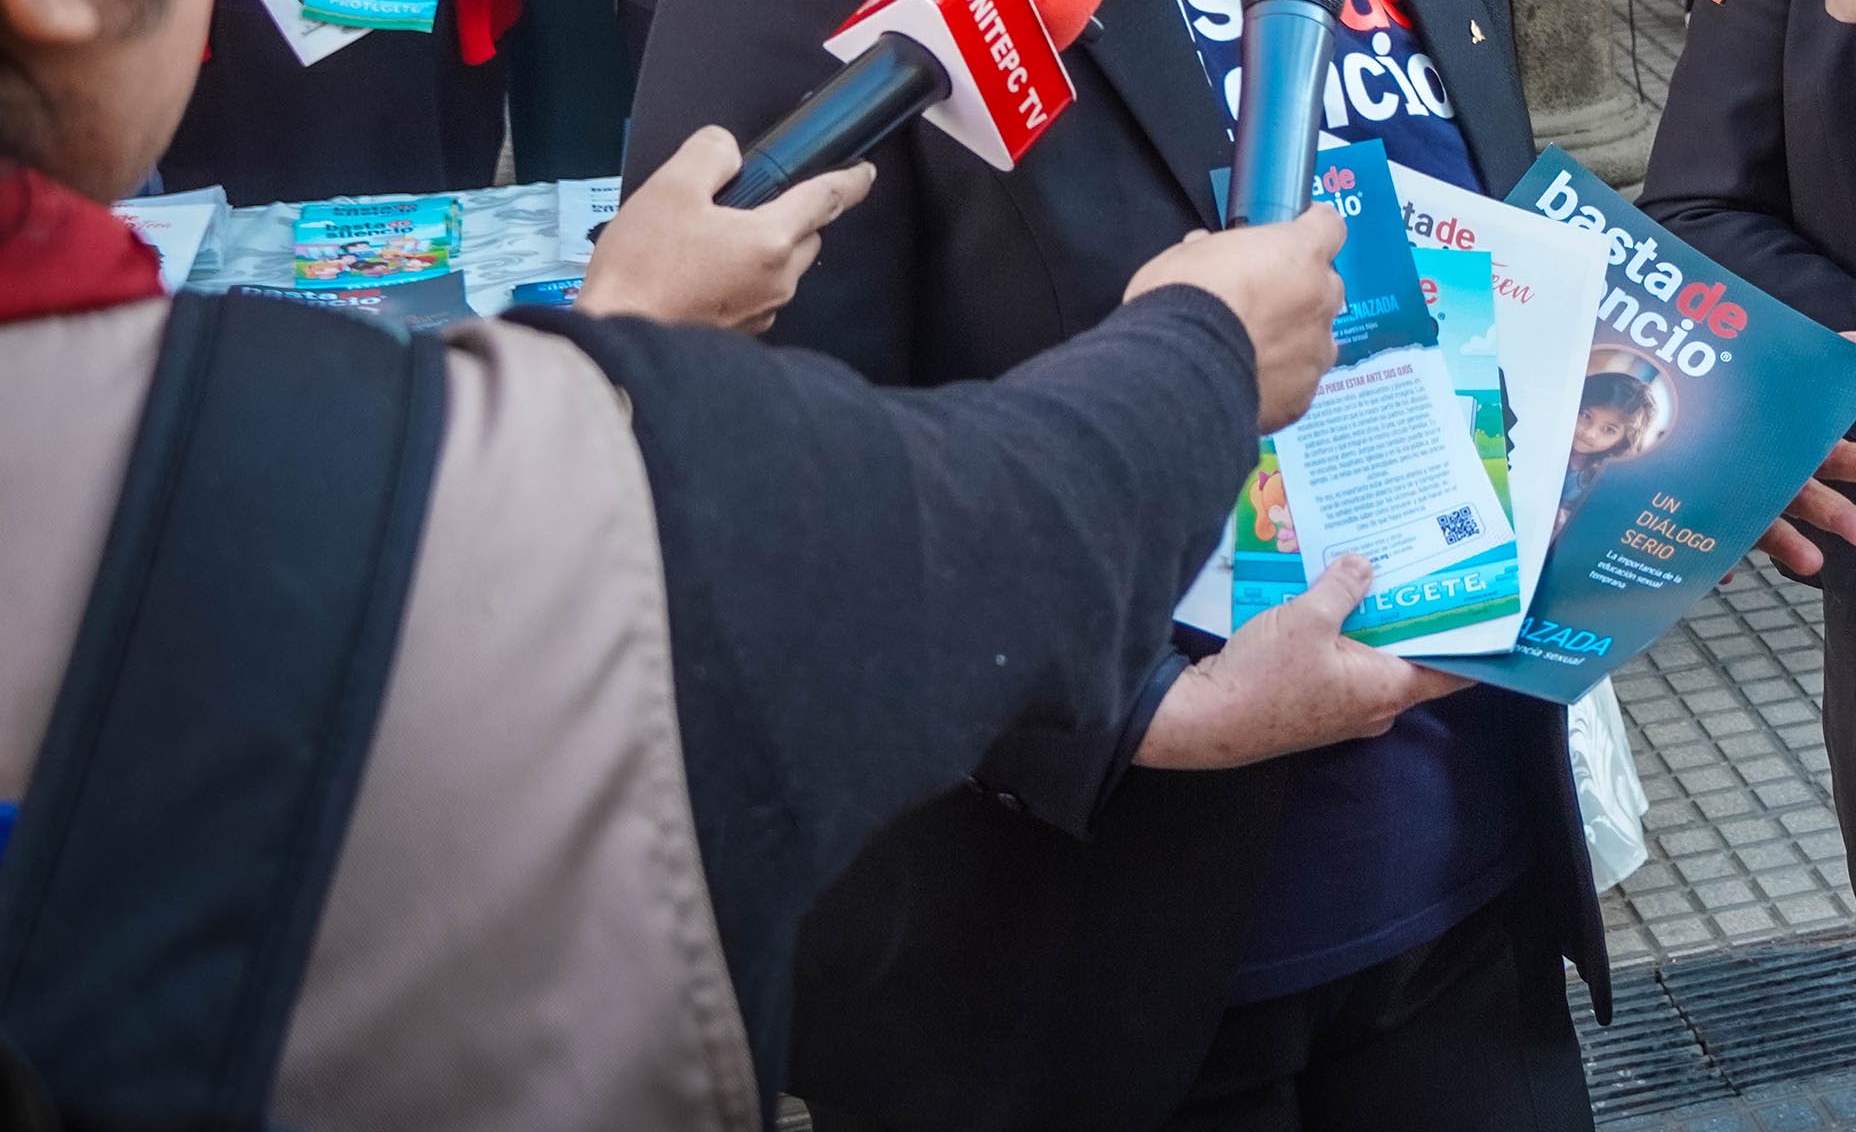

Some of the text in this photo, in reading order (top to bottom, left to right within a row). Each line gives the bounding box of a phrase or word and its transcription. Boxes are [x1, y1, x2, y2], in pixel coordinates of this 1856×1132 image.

[1016, 87, 1050, 132] TV
[1651, 492, 1681, 514] UN
[1621, 528, 1675, 560] SERIO
[1636, 510, 1717, 552] DIÁLOGO
[1589, 570, 1626, 589] temprana
[1606, 549, 1617, 561] La
[1617, 553, 1662, 578] importancia
[1662, 570, 1673, 581] de
[1520, 617, 1613, 657] AZADA
